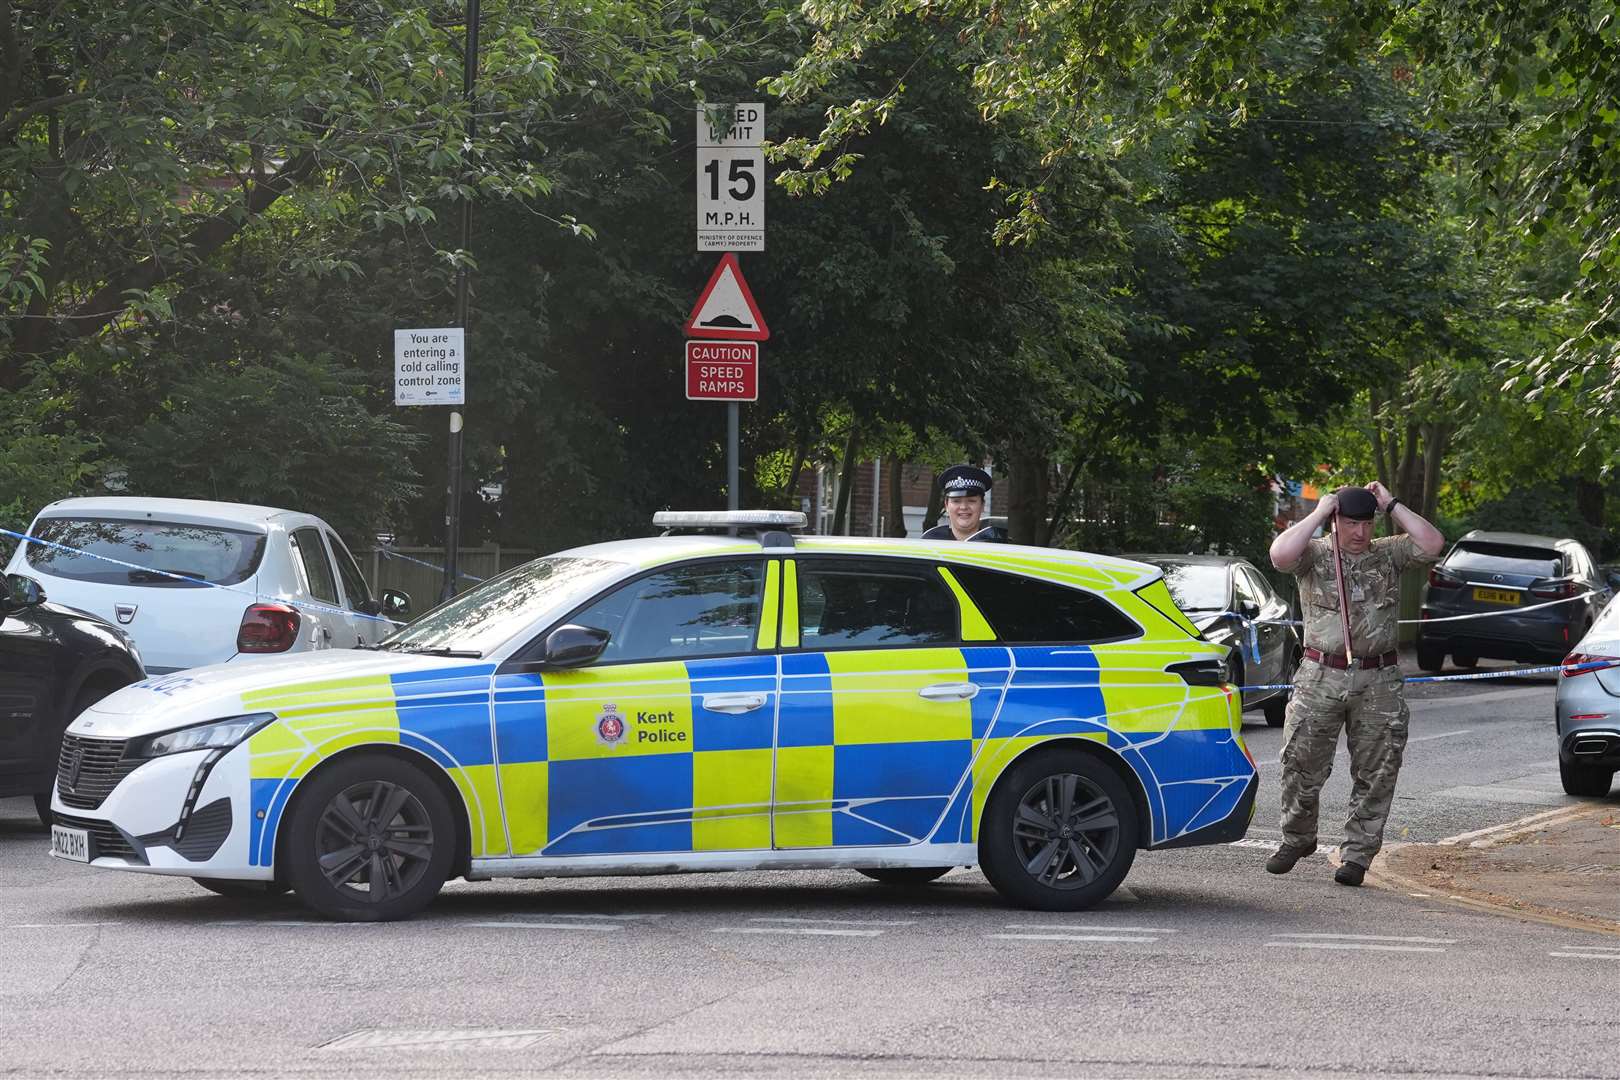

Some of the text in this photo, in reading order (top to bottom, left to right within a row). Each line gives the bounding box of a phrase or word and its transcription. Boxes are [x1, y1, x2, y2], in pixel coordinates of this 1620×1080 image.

[710, 127, 752, 140] LMIT
[704, 159, 756, 201] 15
[706, 212, 755, 225] M.P.H.
[411, 333, 448, 343] You are
[404, 347, 455, 359] entering a
[692, 347, 751, 360] CAUTION
[401, 361, 458, 373] cold calling
[700, 366, 743, 378] SPEED
[399, 375, 461, 386] control zone
[699, 381, 745, 393] RAMPS
[637, 711, 674, 724] Kent
[638, 729, 687, 743] Police
[70, 833, 85, 857] BXH
